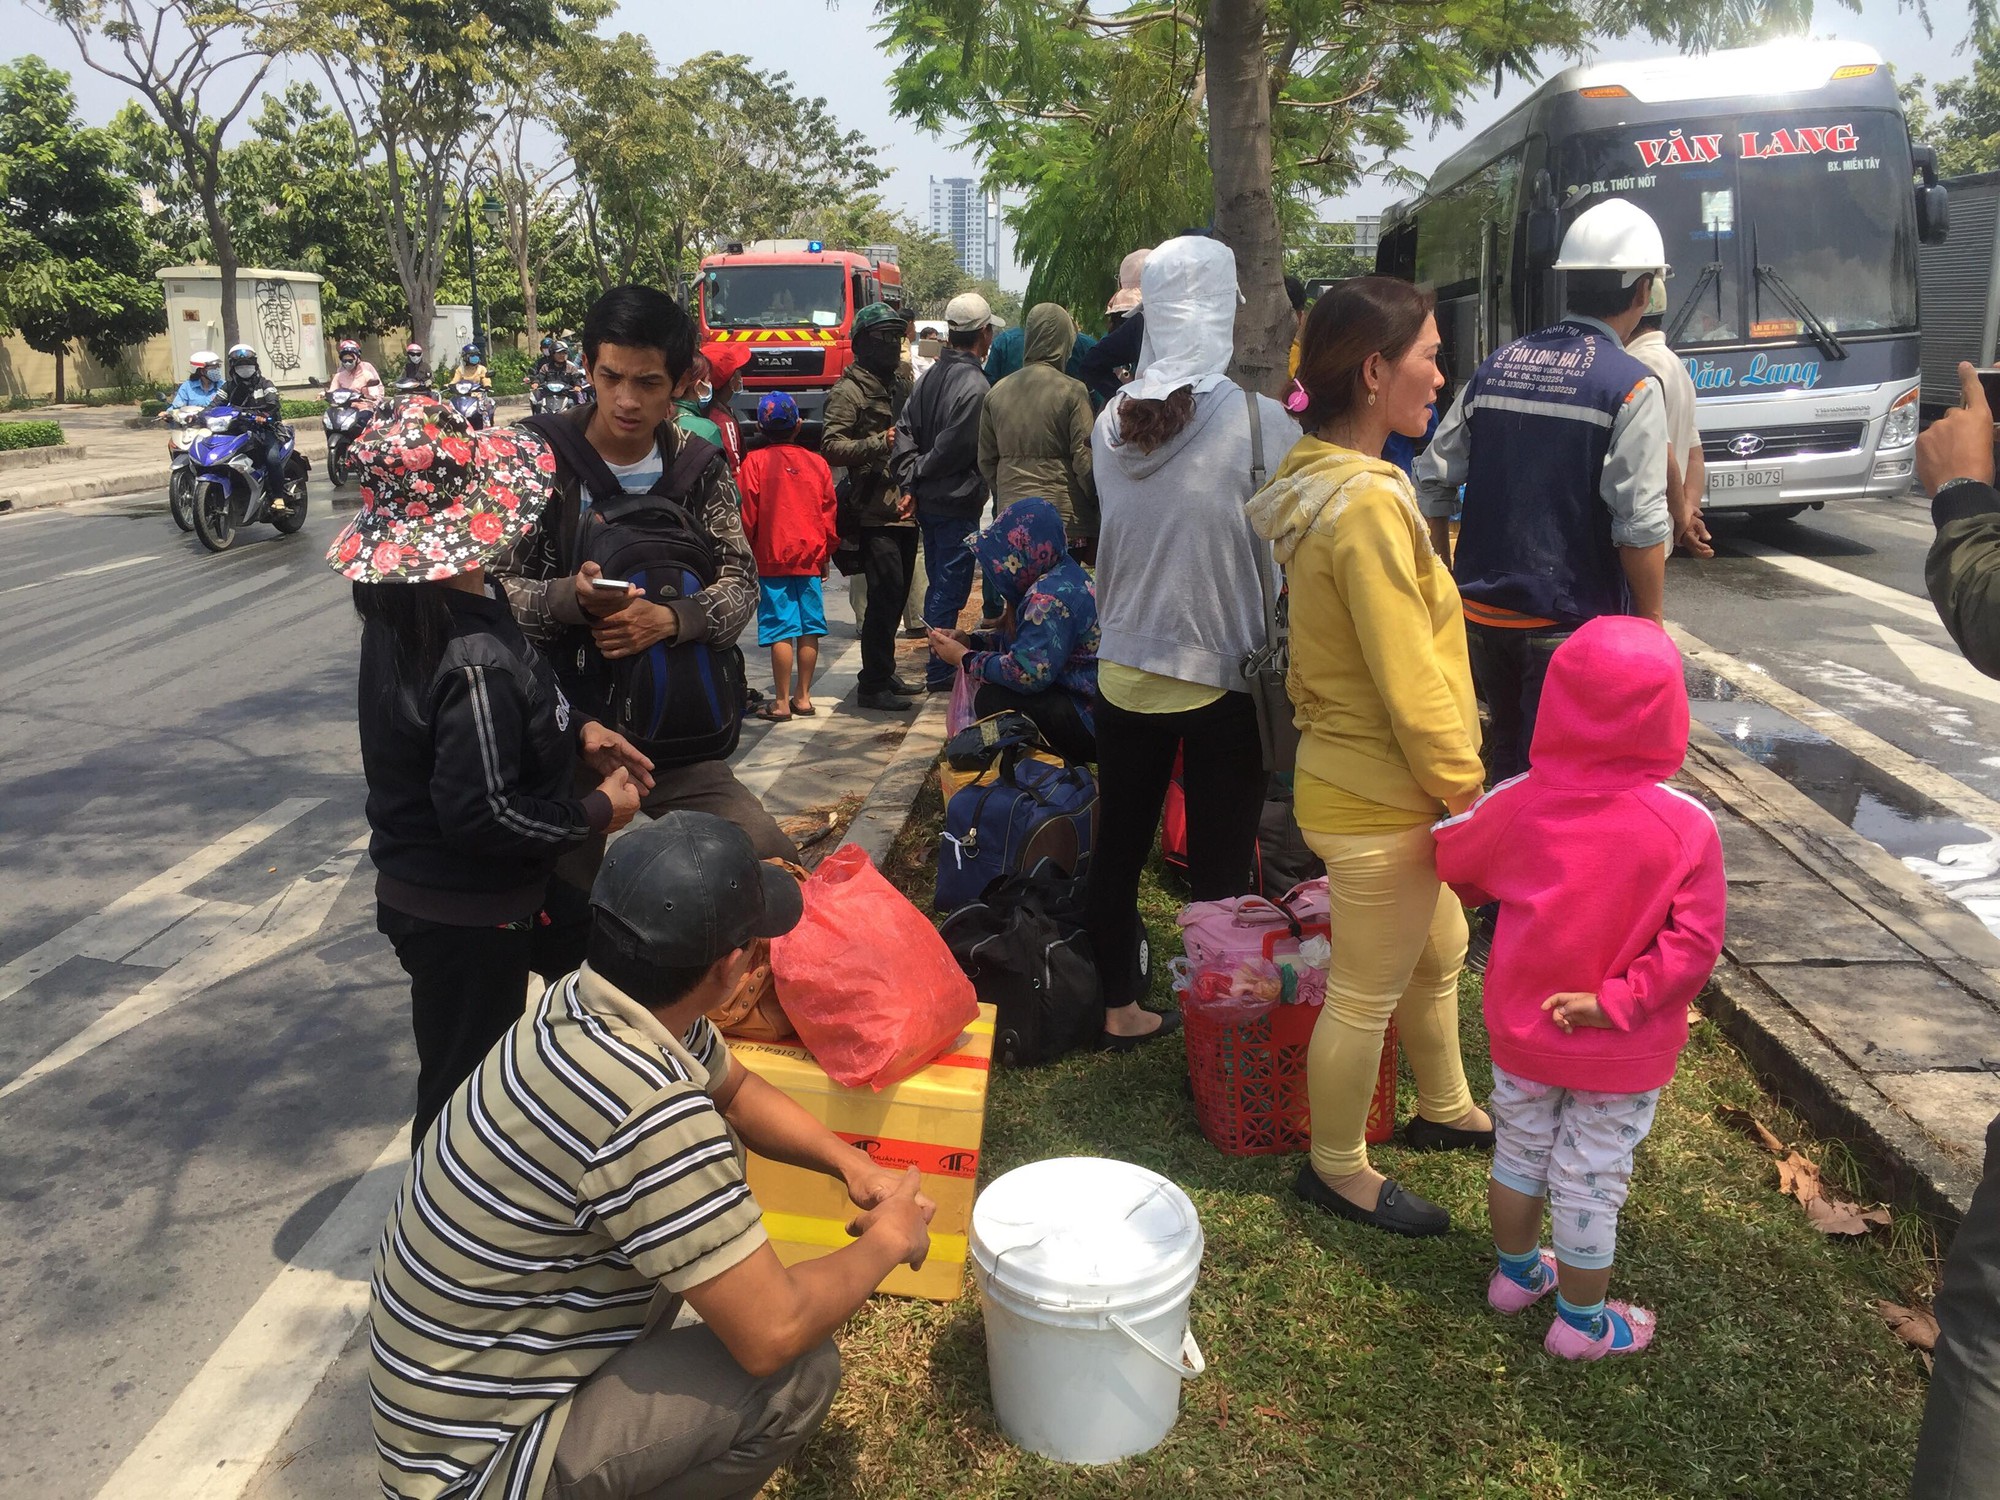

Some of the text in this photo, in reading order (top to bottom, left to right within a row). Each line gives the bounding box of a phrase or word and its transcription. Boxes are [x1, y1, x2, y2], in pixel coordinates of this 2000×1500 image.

[1635, 123, 1859, 168] VĂN LANG
[1827, 160, 1841, 172] BX.
[1592, 180, 1608, 193] BX.
[758, 357, 792, 366] MAN
[1508, 344, 1530, 362] TÂN
[1529, 348, 1560, 367] LONG
[1739, 353, 1822, 389] Lang
